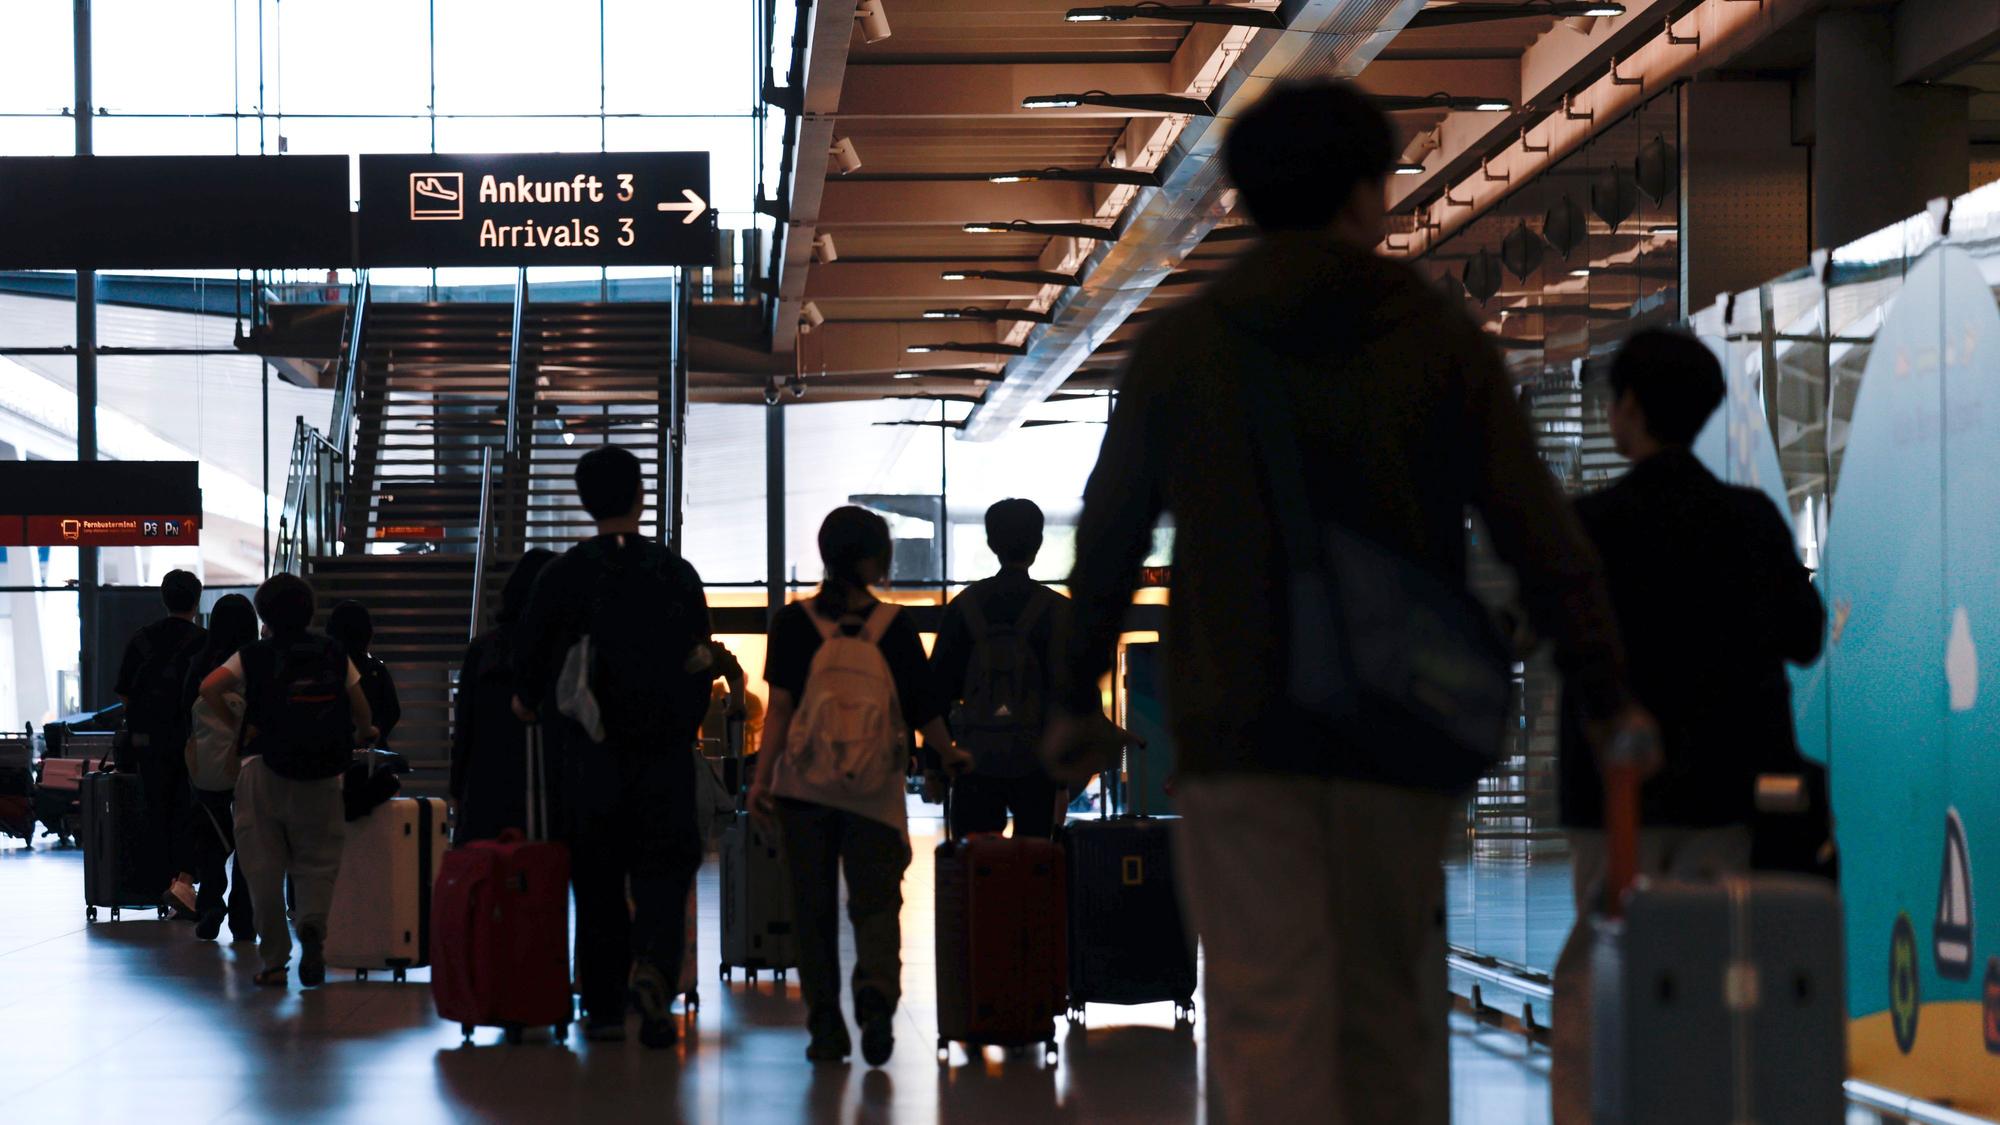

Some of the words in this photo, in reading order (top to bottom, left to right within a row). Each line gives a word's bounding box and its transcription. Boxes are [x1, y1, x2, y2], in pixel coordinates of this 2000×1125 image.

[479, 174, 604, 203] Ankunft
[616, 173, 634, 202] 3
[479, 218, 600, 247] Arrivals
[617, 218, 635, 247] 3
[83, 520, 137, 529] Fernbusterminal
